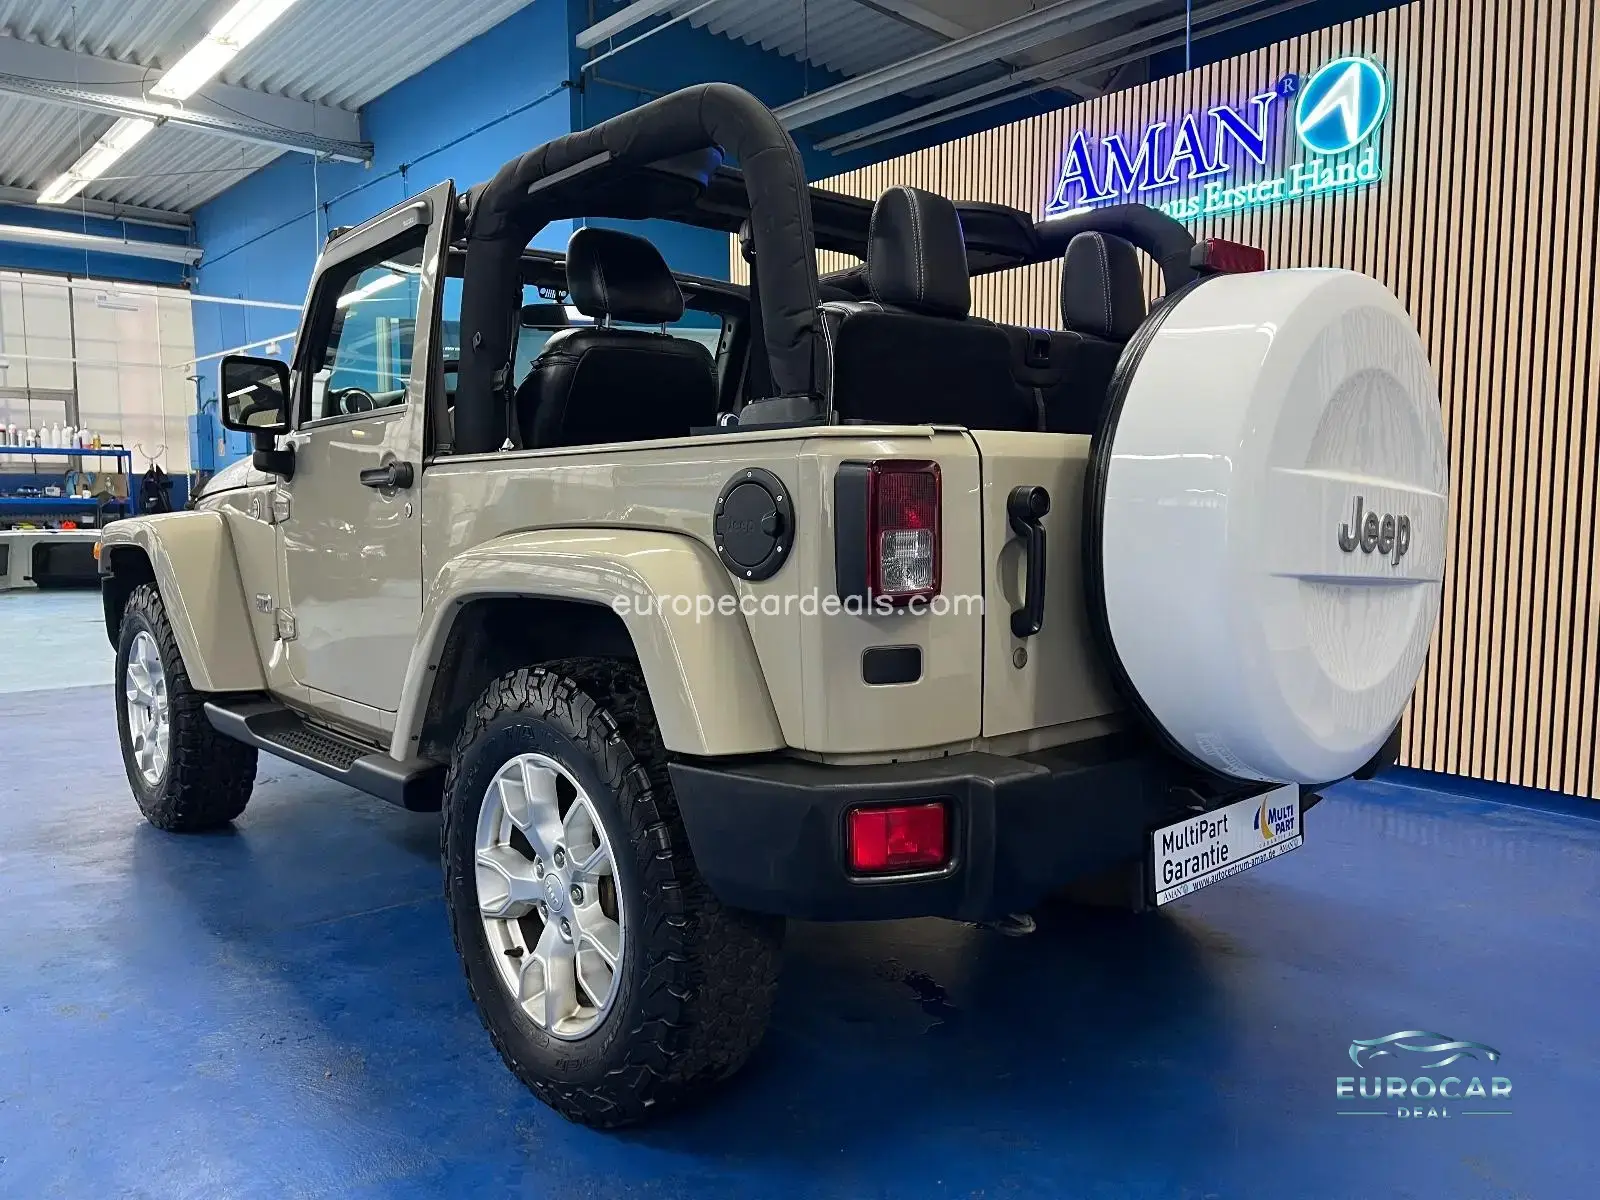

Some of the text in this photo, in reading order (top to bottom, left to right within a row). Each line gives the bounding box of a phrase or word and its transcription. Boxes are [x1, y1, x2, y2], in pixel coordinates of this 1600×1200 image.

[1045, 91, 1277, 212] AMAN
[1203, 177, 1286, 213] Erster
[1288, 147, 1378, 195] Hand
[1337, 495, 1411, 566] Jeep
[1162, 814, 1229, 856] MultiPart
[1268, 804, 1294, 825] MULTI
[1275, 817, 1295, 835] PART
[1163, 841, 1229, 884] Garantie
[1192, 849, 1276, 890] www.autocentrum-aman.de
